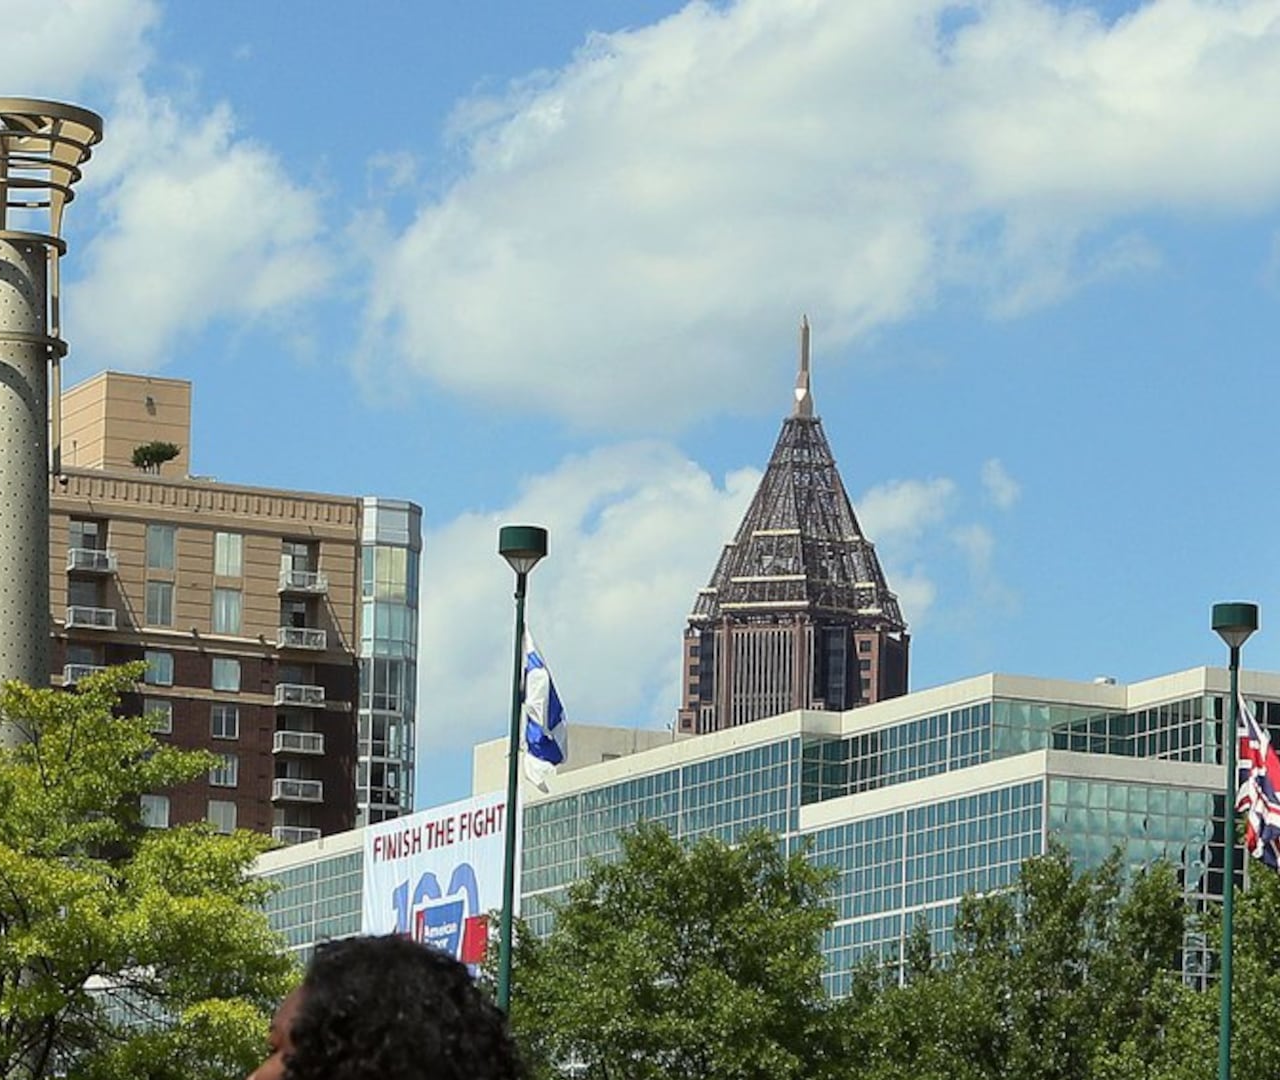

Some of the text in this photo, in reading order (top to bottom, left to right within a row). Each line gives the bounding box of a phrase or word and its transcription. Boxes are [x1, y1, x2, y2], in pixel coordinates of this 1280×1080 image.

[373, 804, 505, 864] FINISH THE FIGHT
